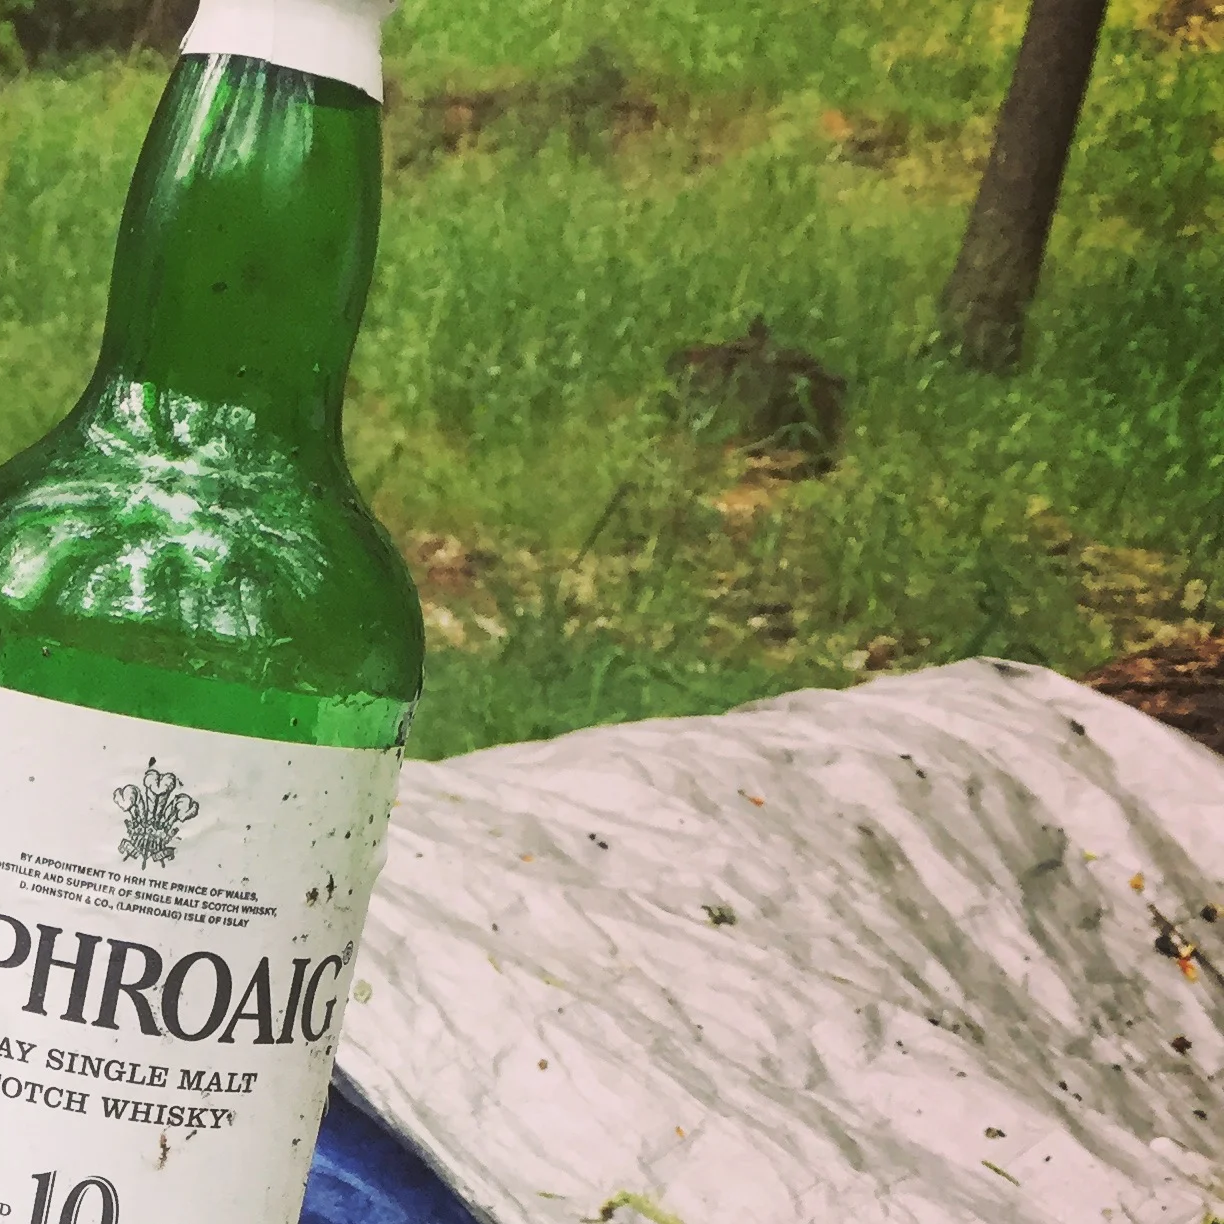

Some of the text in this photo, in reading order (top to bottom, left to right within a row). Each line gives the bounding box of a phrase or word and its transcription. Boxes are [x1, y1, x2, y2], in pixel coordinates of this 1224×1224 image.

[20, 852, 259, 902] BY APPOINTMENT TO HRH THE PRINCE OF WALES,
[43, 872, 64, 884] AND
[66, 877, 116, 895] SUPPLIER
[118, 888, 132, 898] OF
[134, 891, 172, 904] SINGLE
[174, 896, 200, 908] MALT
[202, 900, 239, 914] SCOTCH
[241, 905, 277, 918] WHISKY,
[19, 880, 29, 891] D.
[30, 883, 83, 902] JOHNSTON
[84, 896, 91, 905] &
[116, 901, 182, 921] (LAPHROAIG)
[184, 912, 206, 924] ISLE
[208, 915, 222, 925] OF
[223, 917, 250, 928] ISLAY
[45, 1048, 170, 1088] SINGLE
[176, 1068, 259, 1094] MALT
[101, 1096, 229, 1130] WHISKY
